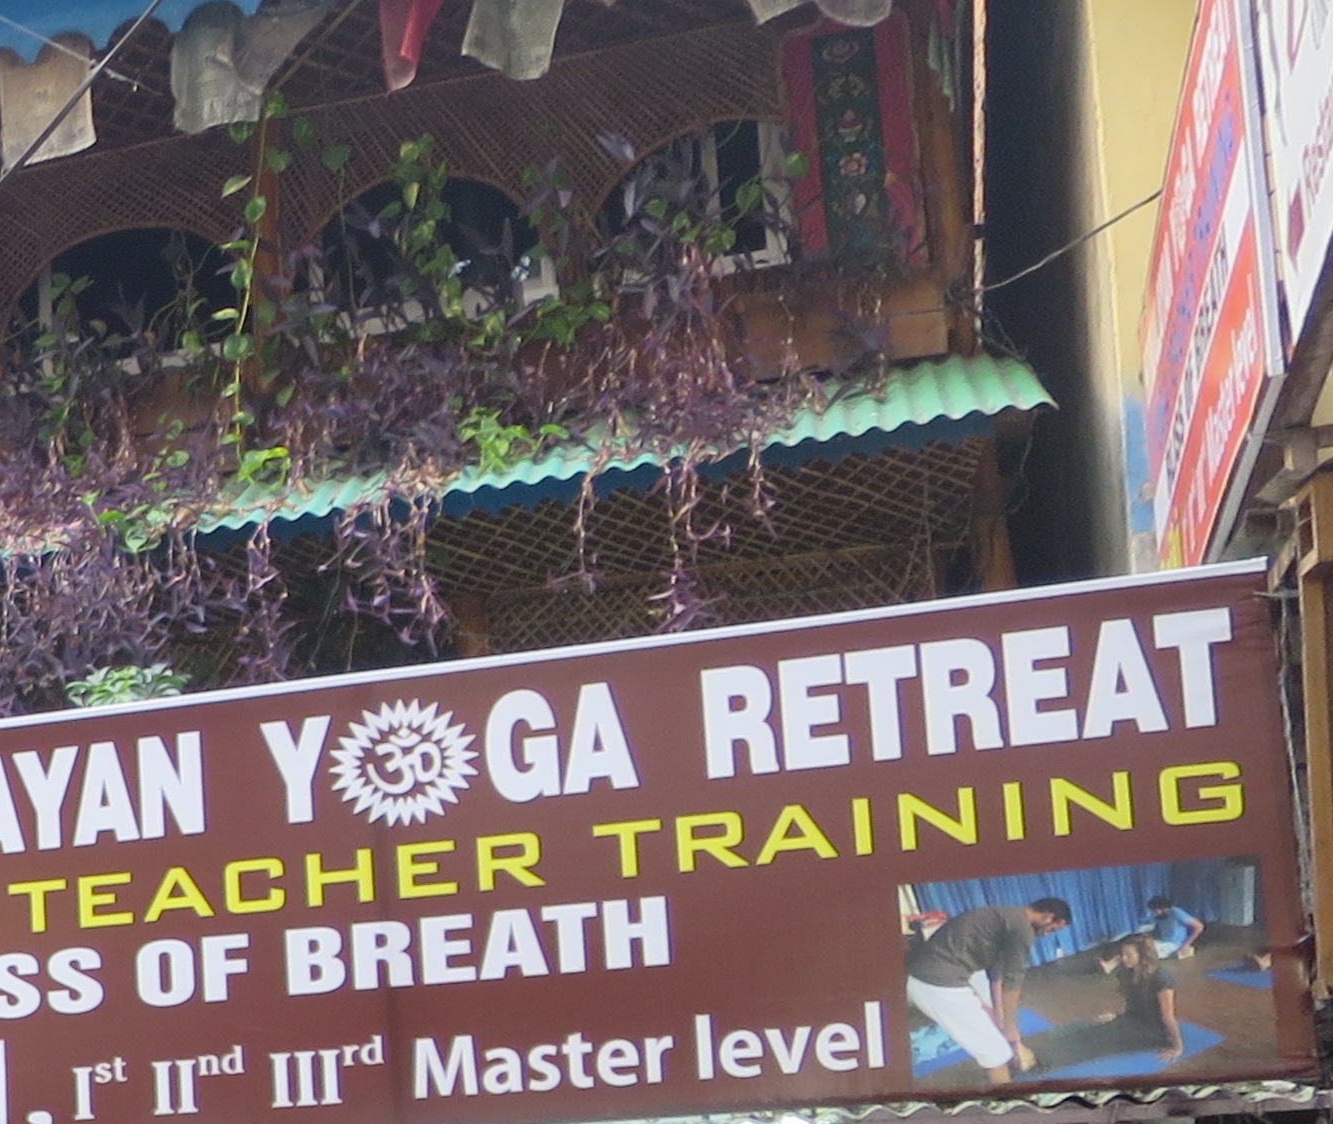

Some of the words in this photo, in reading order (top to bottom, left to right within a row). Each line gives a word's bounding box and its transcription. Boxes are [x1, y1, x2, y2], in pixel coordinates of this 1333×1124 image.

[700, 606, 1236, 783] RETREAT
[7, 832, 544, 933] TEACHER
[590, 760, 1249, 877] TRAINING
[136, 934, 250, 1014] OF
[283, 894, 674, 1001] BREATH
[412, 1024, 679, 1103] Master
[693, 1000, 888, 1081] level
